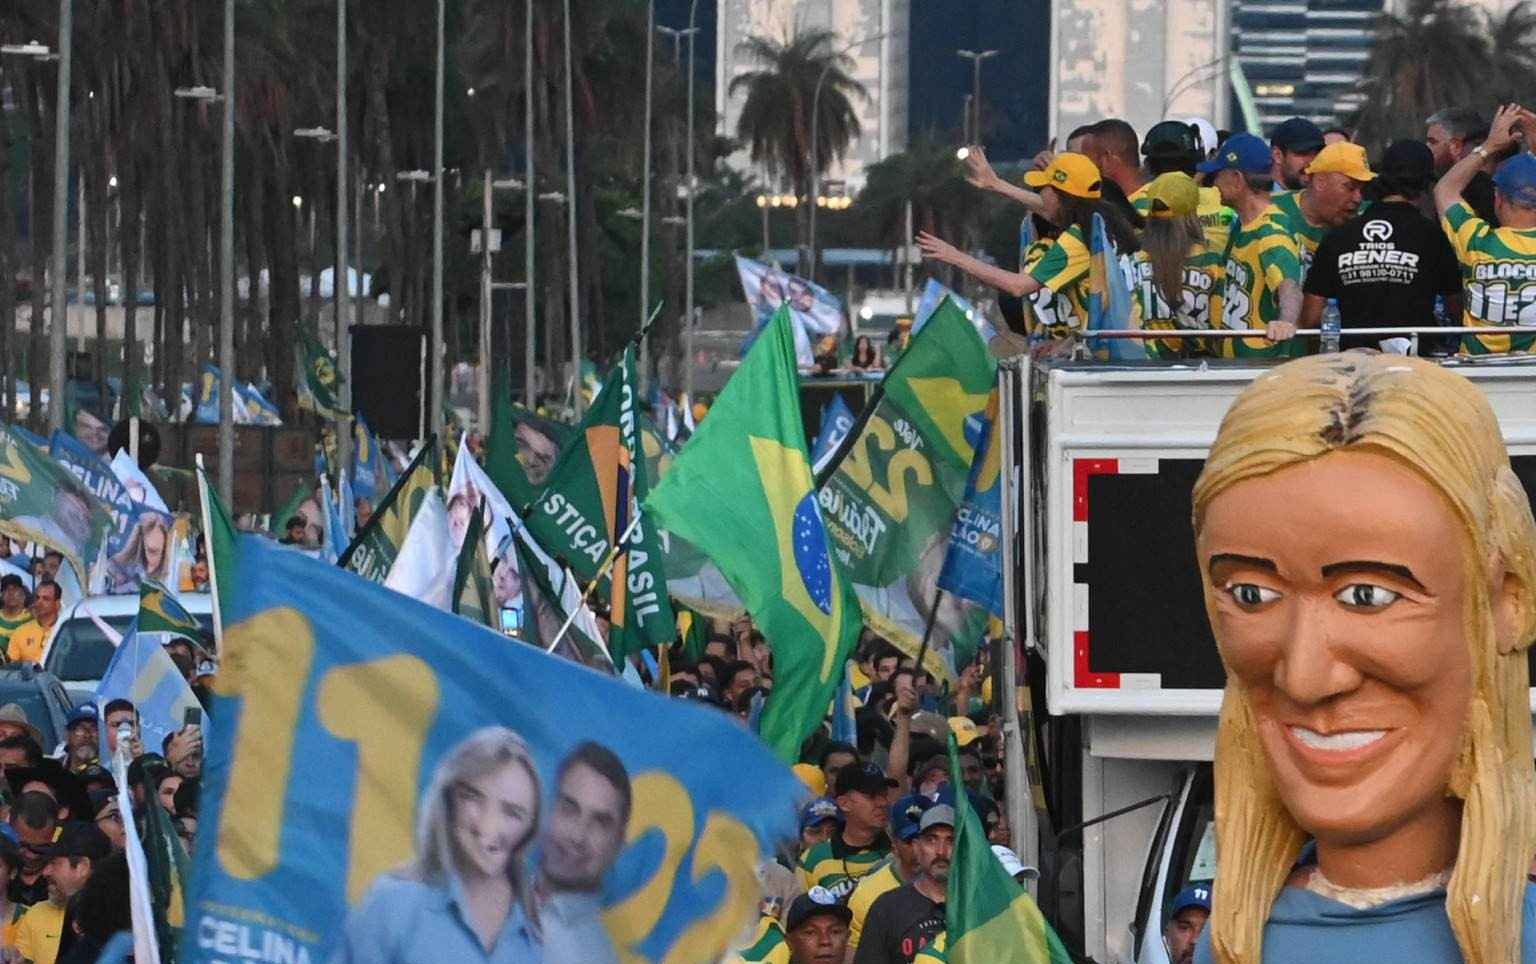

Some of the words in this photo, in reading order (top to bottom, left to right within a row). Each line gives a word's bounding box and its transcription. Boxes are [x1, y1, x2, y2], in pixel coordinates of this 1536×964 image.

[1359, 242, 1395, 250] TRIOS
[1338, 250, 1420, 268] RENER
[543, 492, 610, 565] STIÇA
